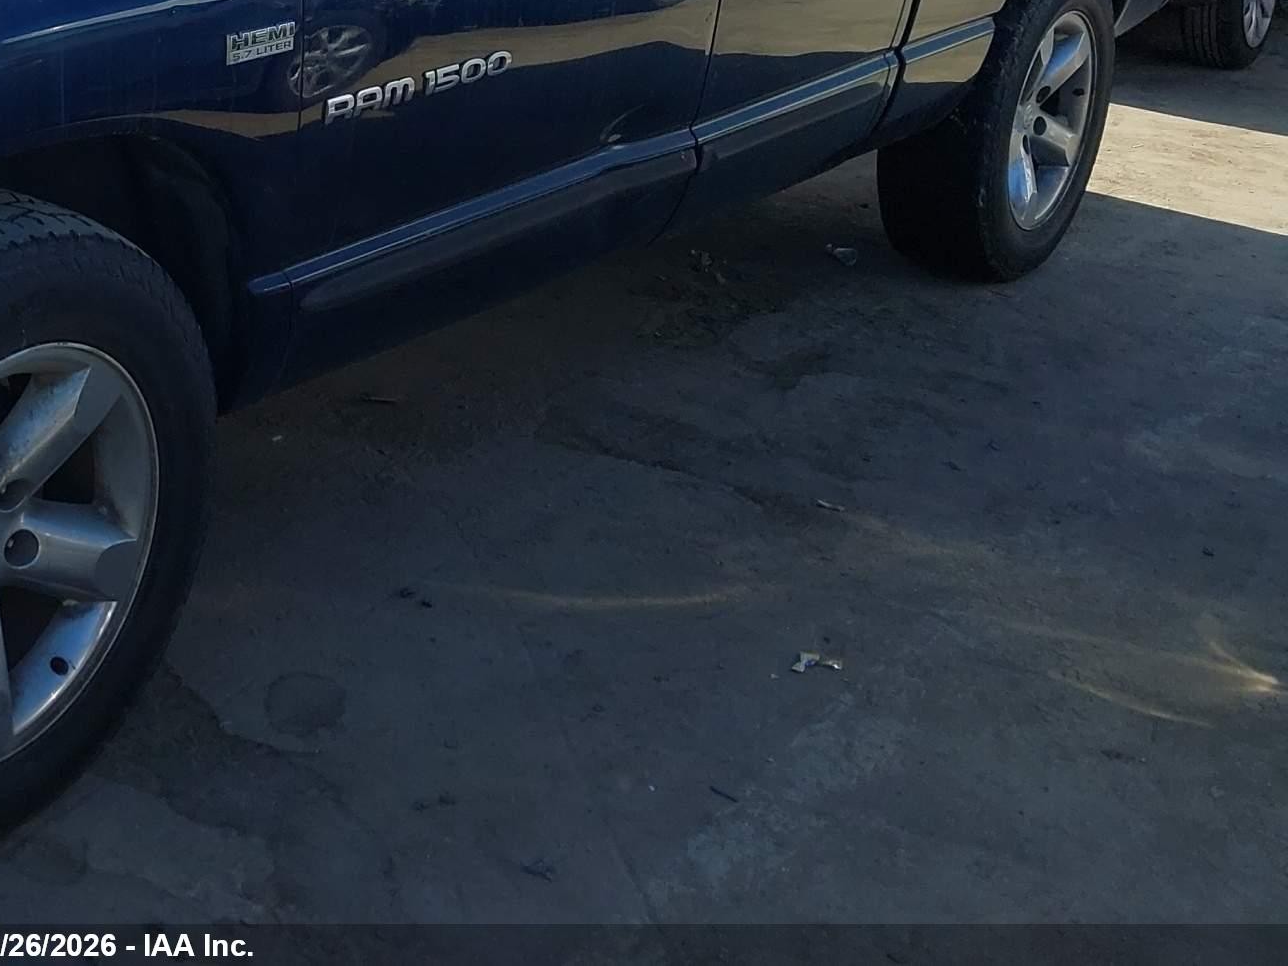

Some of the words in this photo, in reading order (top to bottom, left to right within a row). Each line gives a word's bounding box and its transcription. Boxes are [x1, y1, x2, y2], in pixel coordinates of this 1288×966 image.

[231, 21, 296, 50] HEMI
[233, 49, 253, 61] 5.7
[256, 40, 293, 56] LITER
[324, 76, 415, 126] RAM
[423, 50, 512, 95] 1500
